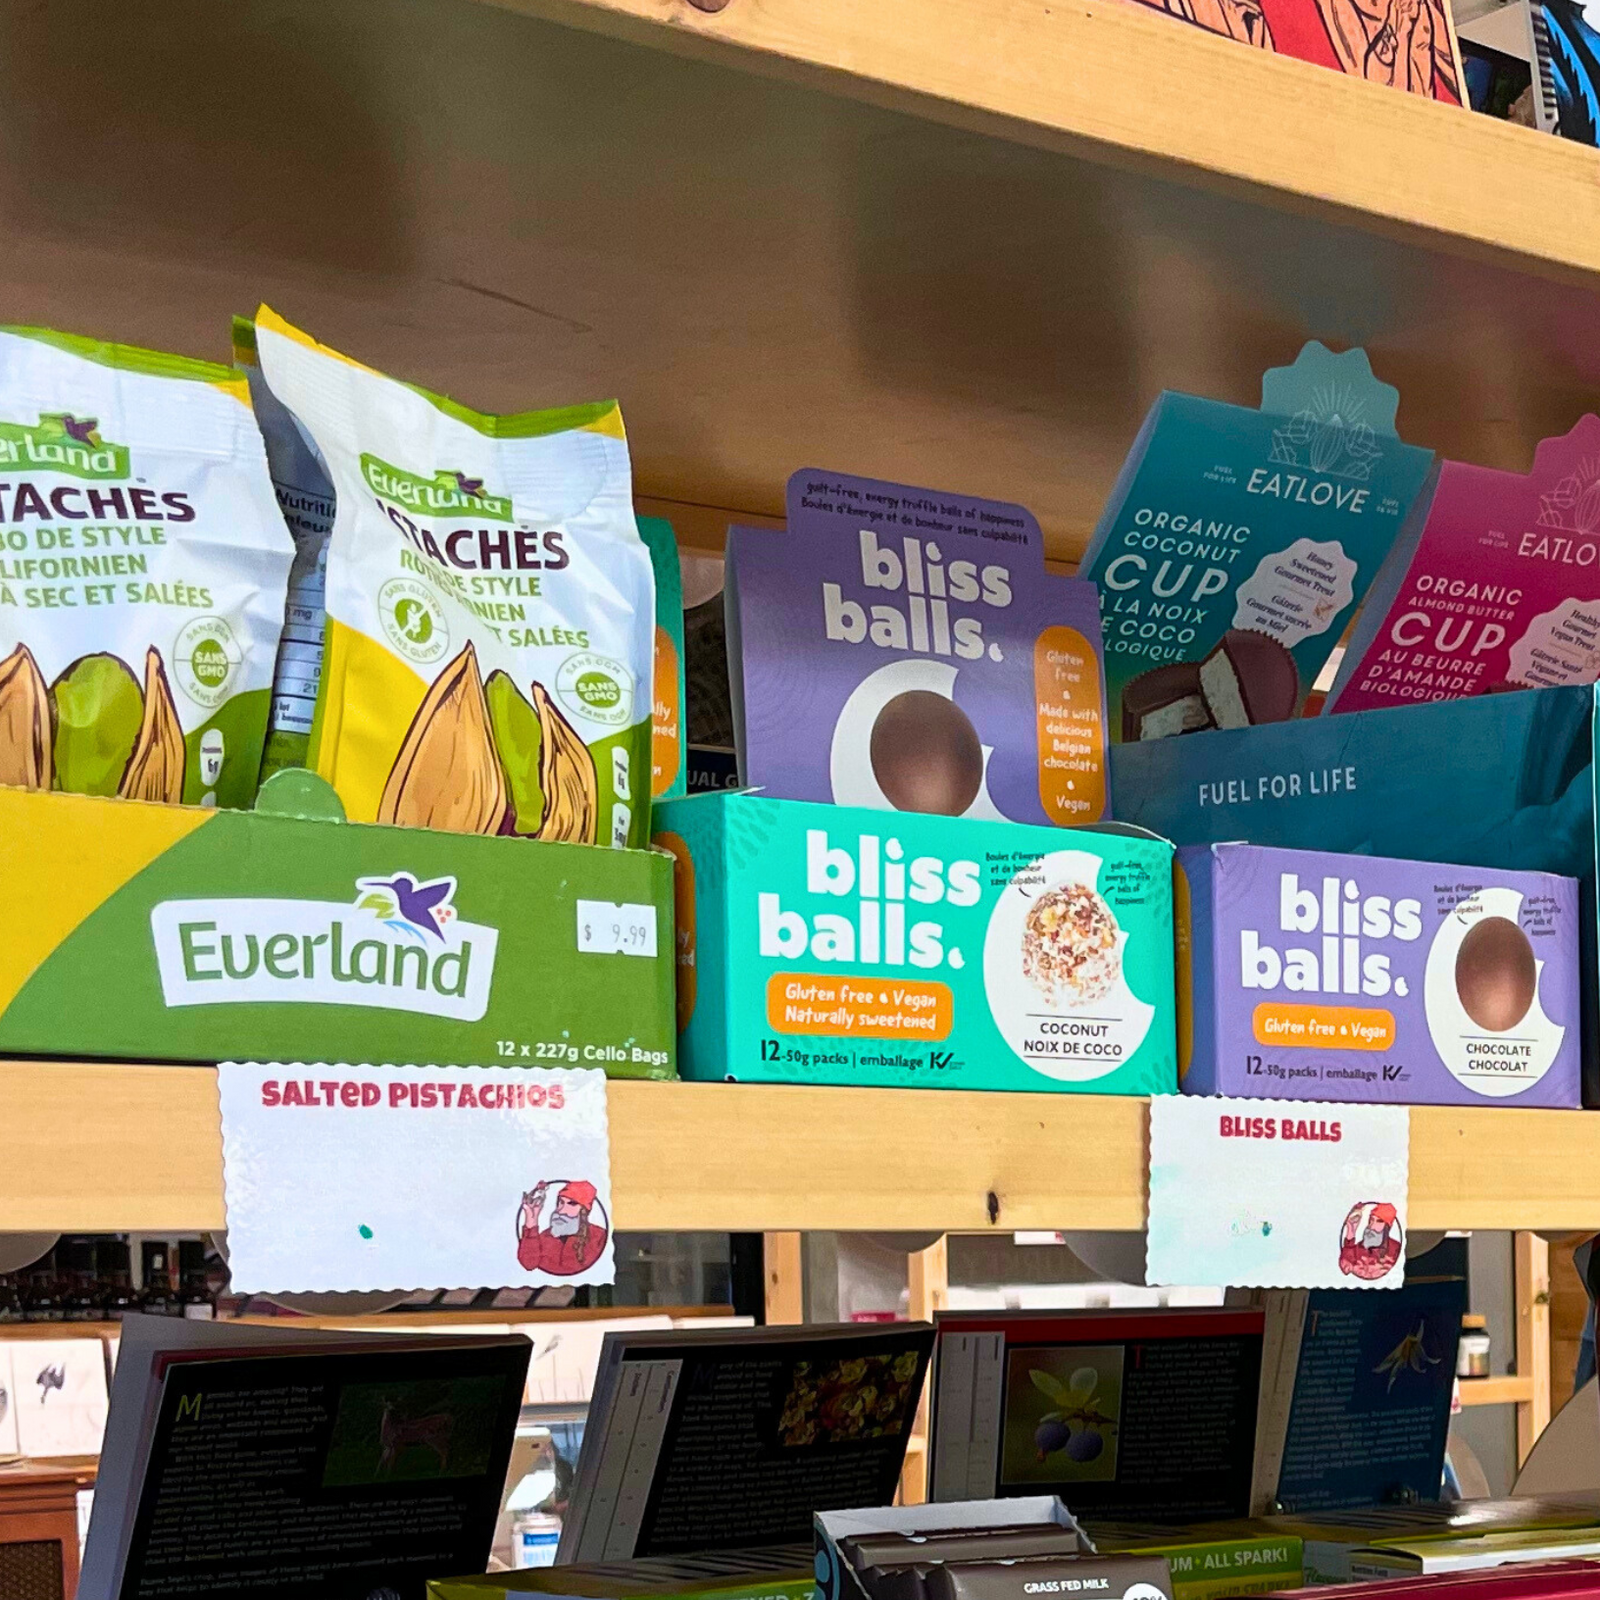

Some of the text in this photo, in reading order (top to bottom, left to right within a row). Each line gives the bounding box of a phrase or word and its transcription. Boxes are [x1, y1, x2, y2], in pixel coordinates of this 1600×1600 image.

[1246, 467, 1371, 516] EATLOVE
[1134, 508, 1251, 543] ORGANIC
[1124, 532, 1241, 564] COCONUT
[859, 530, 1012, 607] bliss
[1103, 554, 1230, 603] CUP
[1199, 767, 1357, 806] FUEL FOR LIFE
[806, 830, 981, 907] bliss
[1280, 873, 1422, 941] bliss
[611, 925, 647, 946] 9.99
[179, 921, 472, 998] Everland
[785, 984, 936, 1010] Gluten free Vegan
[785, 1007, 936, 1030] Naturally sweetened
[1040, 1022, 1108, 1037] COCONUT
[496, 1041, 668, 1065] 12 x 227g Cello Bags
[1024, 1040, 1122, 1056] NOIX DE COCO
[1466, 1043, 1532, 1057] CHOCOLATE
[1468, 1059, 1528, 1072] CHOCOLAT
[1219, 1115, 1341, 1142] BLISS BALLS
[1023, 1578, 1108, 1594] GRASS FED MILK
